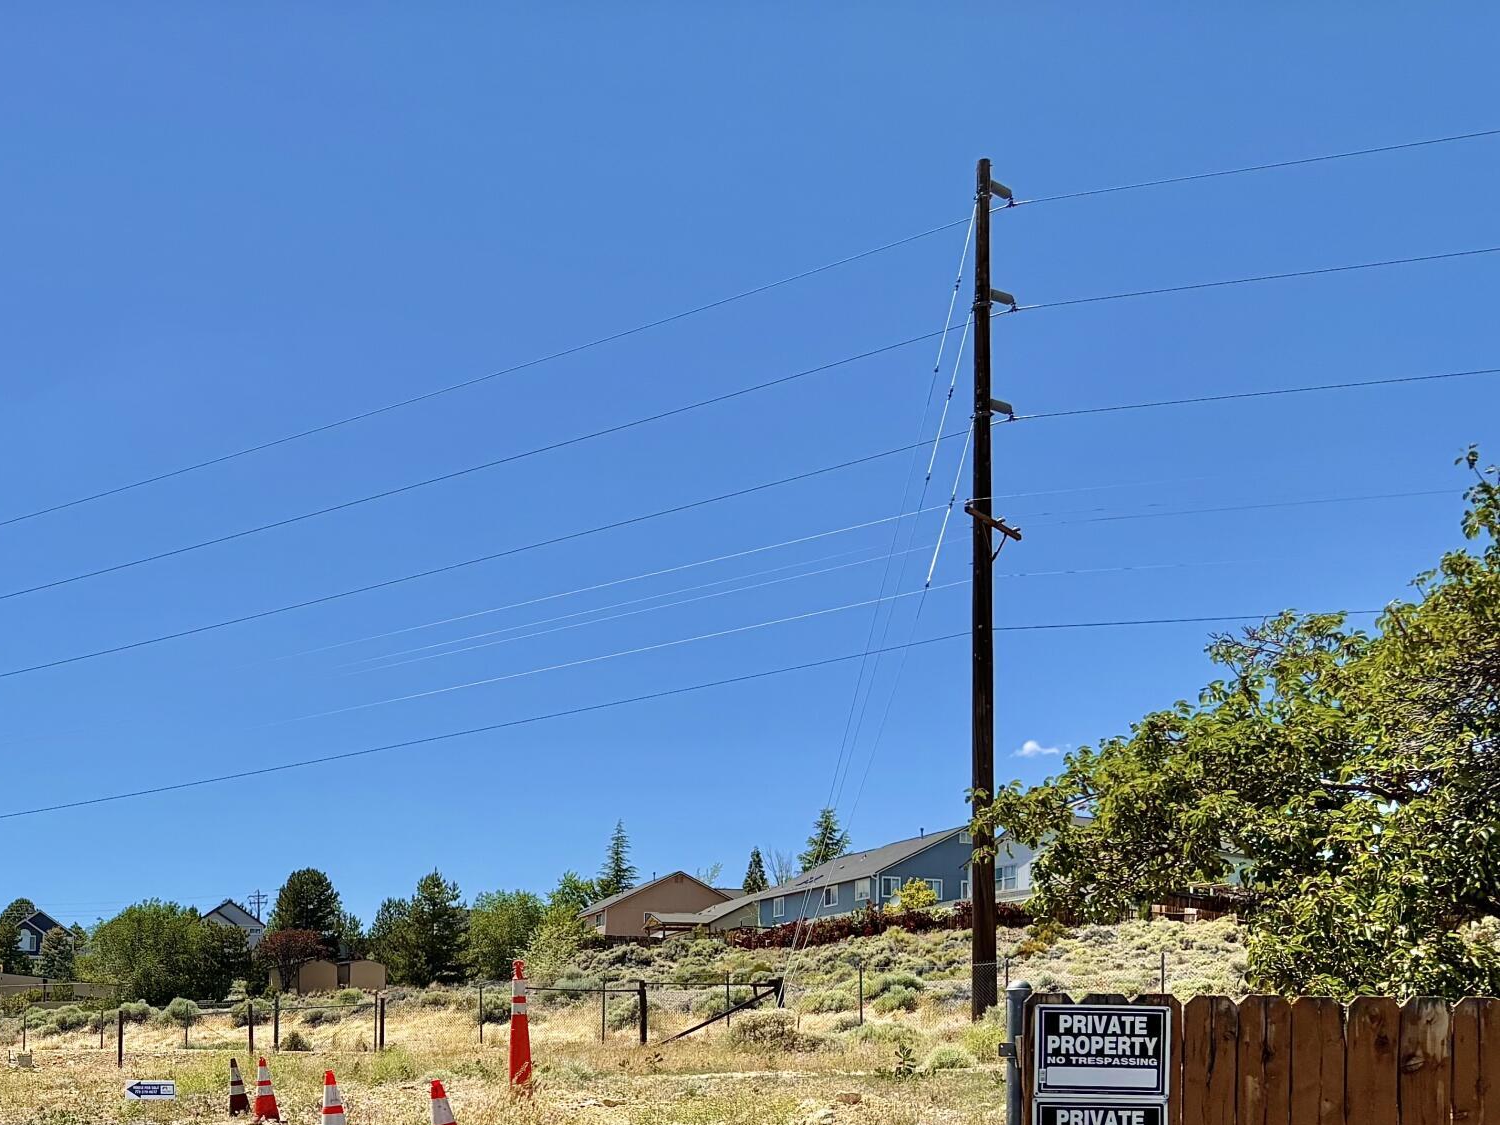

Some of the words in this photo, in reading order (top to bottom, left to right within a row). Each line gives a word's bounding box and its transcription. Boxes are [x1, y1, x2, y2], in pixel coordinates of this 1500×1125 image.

[1058, 1014, 1148, 1035] PRIVATE
[1046, 1035, 1158, 1056] PROPERTY
[1046, 1056, 1066, 1064] NO
[1069, 1056, 1158, 1066] TRESPASSING
